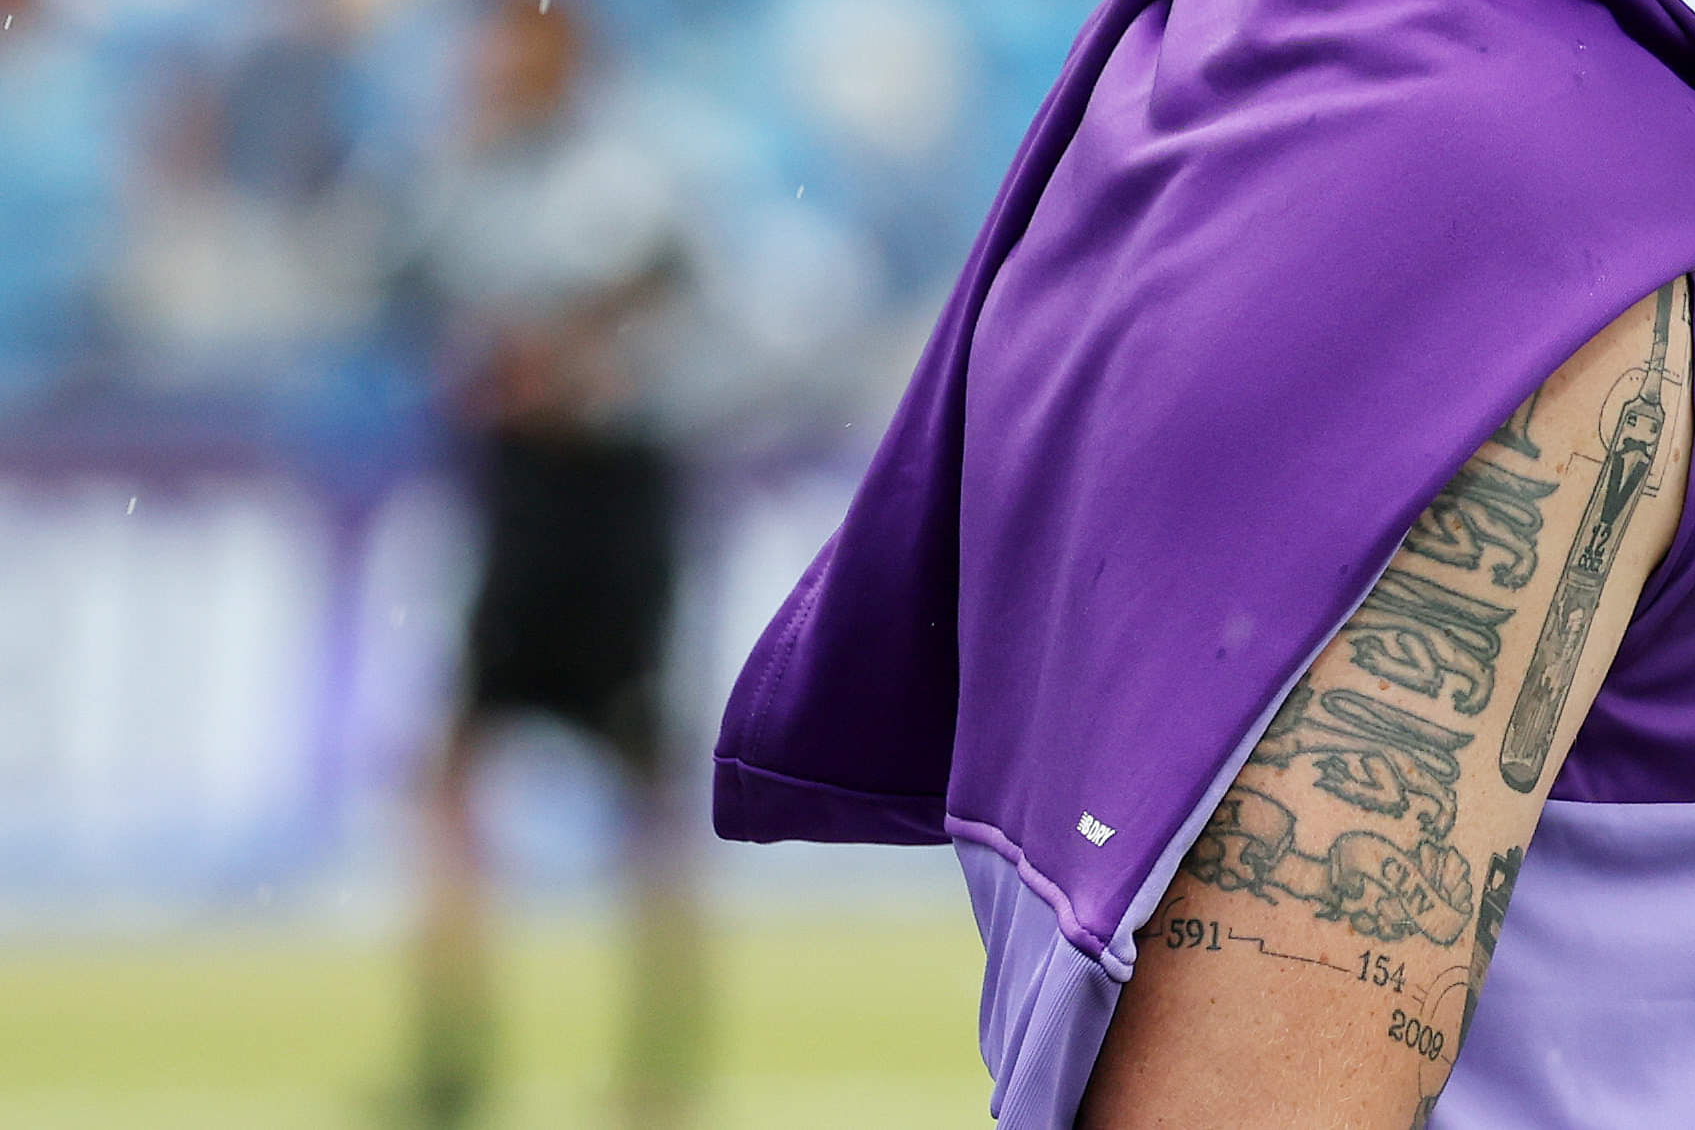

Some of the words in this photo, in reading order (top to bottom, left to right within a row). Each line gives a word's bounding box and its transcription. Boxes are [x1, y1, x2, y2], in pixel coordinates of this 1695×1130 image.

[1166, 918, 1222, 950] 591
[1357, 949, 1406, 994] 154
[1387, 1008, 1445, 1061] 2009
